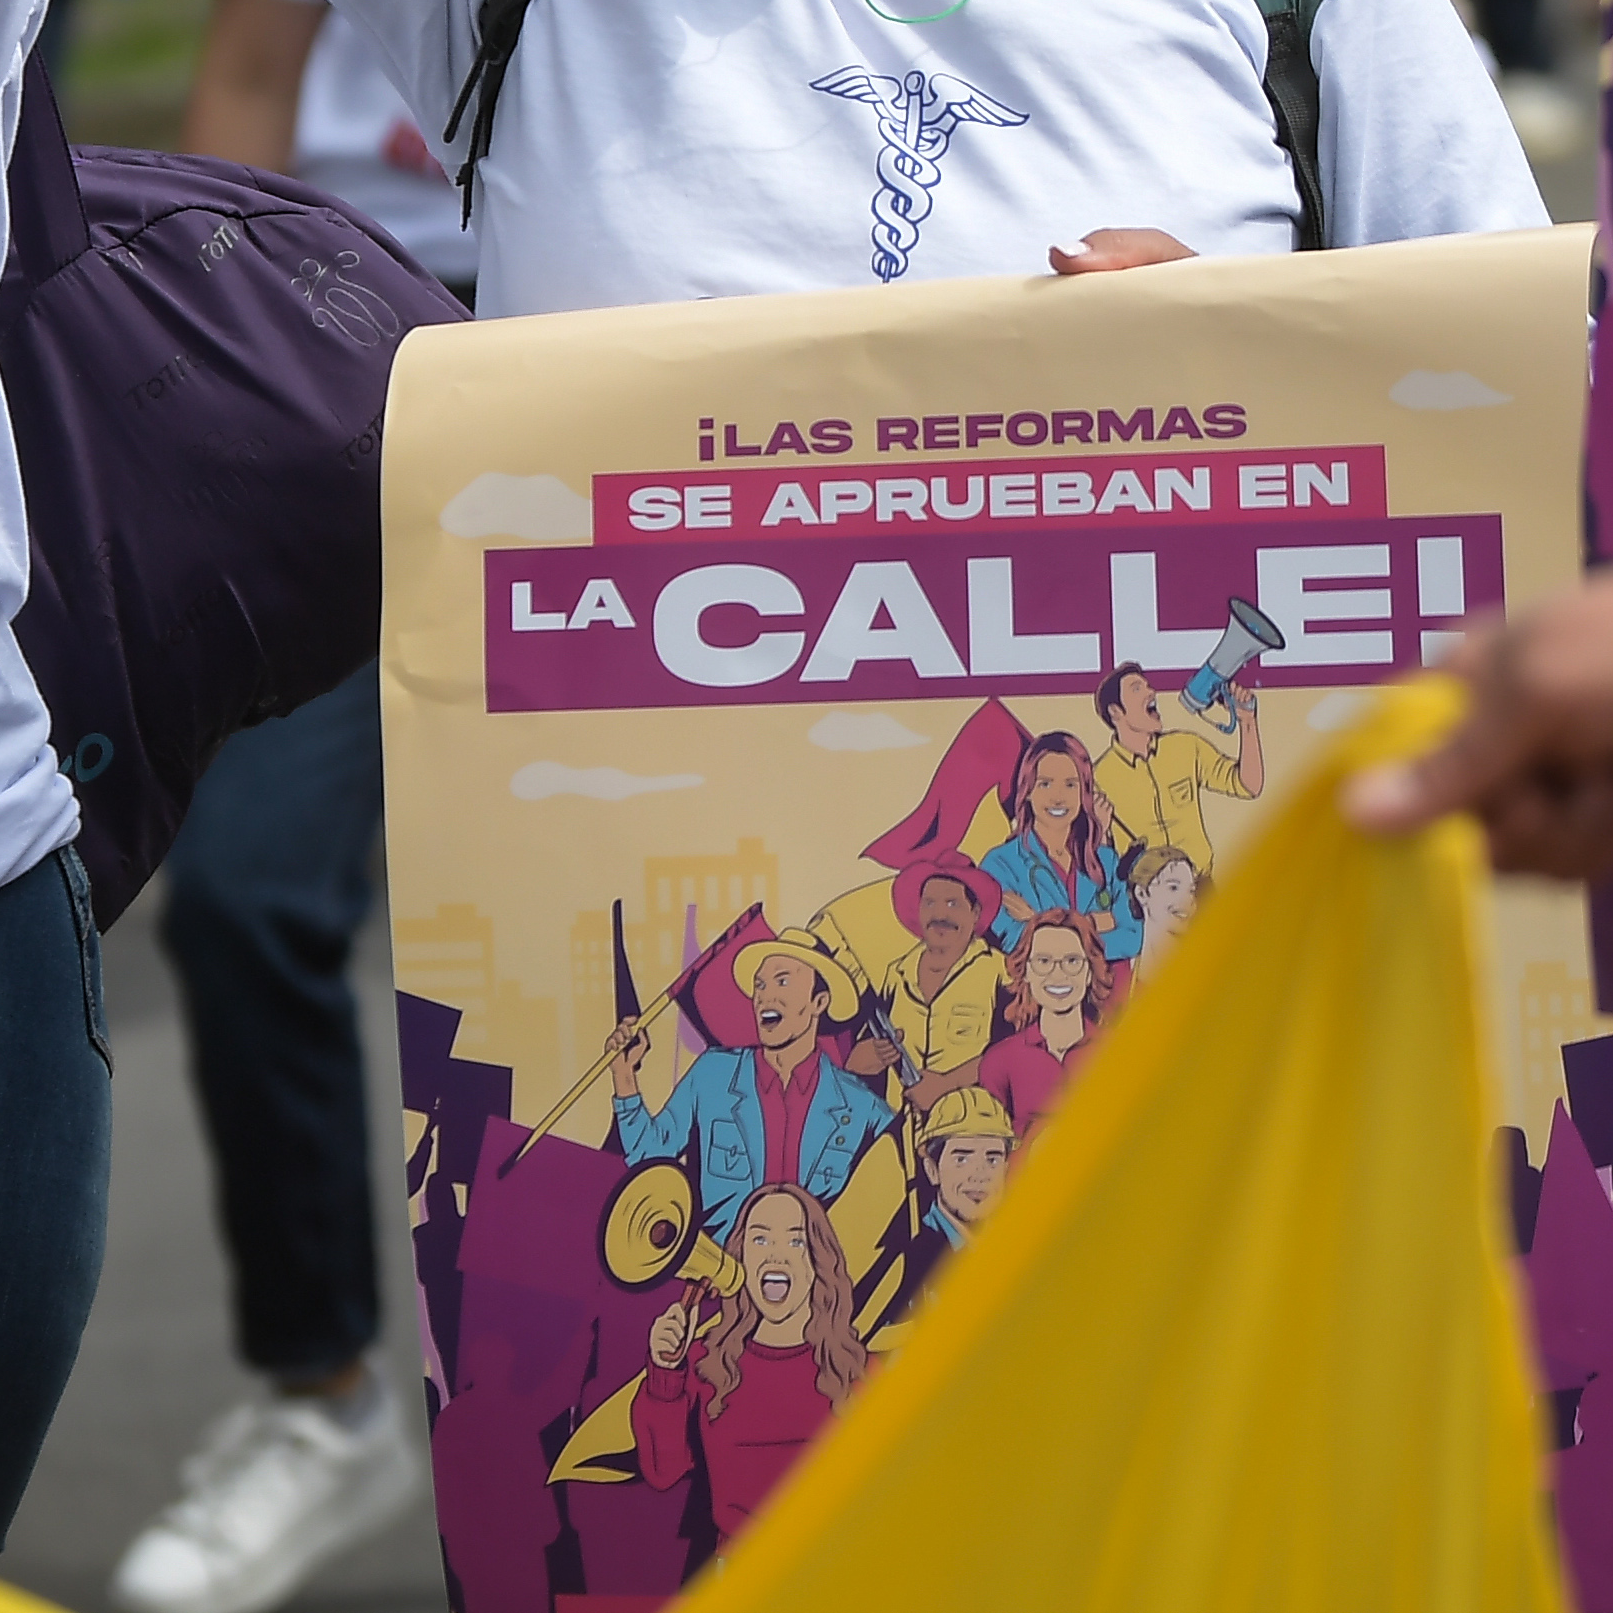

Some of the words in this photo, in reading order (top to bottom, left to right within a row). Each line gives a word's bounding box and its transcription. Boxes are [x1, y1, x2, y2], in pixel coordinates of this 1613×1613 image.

[874, 402, 1249, 453] REFORMAS
[626, 484, 734, 532] SE
[759, 466, 1212, 528] APRUEBAN
[1237, 460, 1351, 510] EN
[510, 577, 637, 632] LA
[651, 535, 1466, 688] CALLE!
